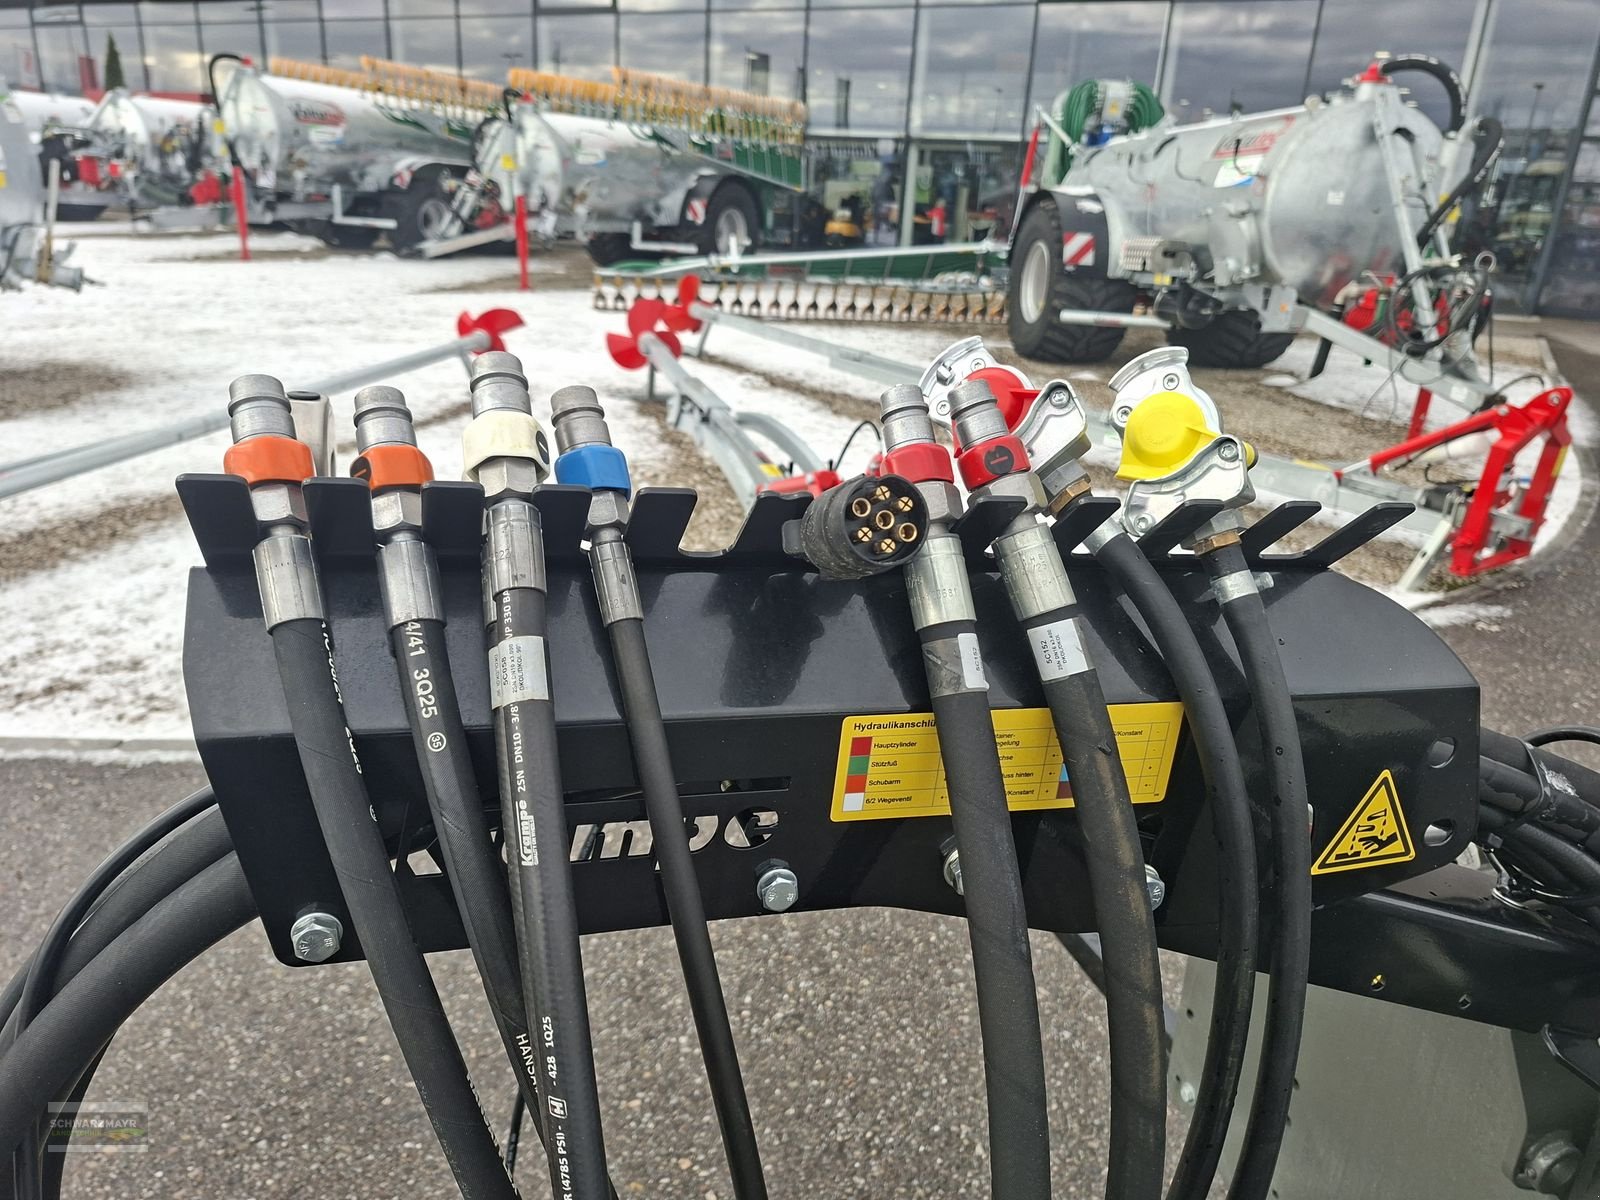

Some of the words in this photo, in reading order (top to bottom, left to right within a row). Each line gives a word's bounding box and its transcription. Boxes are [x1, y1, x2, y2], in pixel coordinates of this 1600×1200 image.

[503, 590, 511, 603] BA
[503, 605, 512, 625] 330
[1040, 640, 1053, 664] 5C152
[413, 668, 438, 719] 3Q25
[431, 734, 442, 749] 35
[853, 719, 936, 732] Hydraulikanschlü
[513, 732, 524, 764] DN10
[873, 741, 917, 750] Hauptzylinder
[871, 760, 898, 768] Stützfuß
[516, 770, 526, 793] 2SN
[877, 796, 912, 804] Wegeventil
[515, 799, 535, 867] Krampe
[542, 1016, 555, 1048] 1Q25
[546, 1055, 558, 1078] 428
[555, 1132, 568, 1155] PSI)
[558, 1157, 573, 1192] (4785
